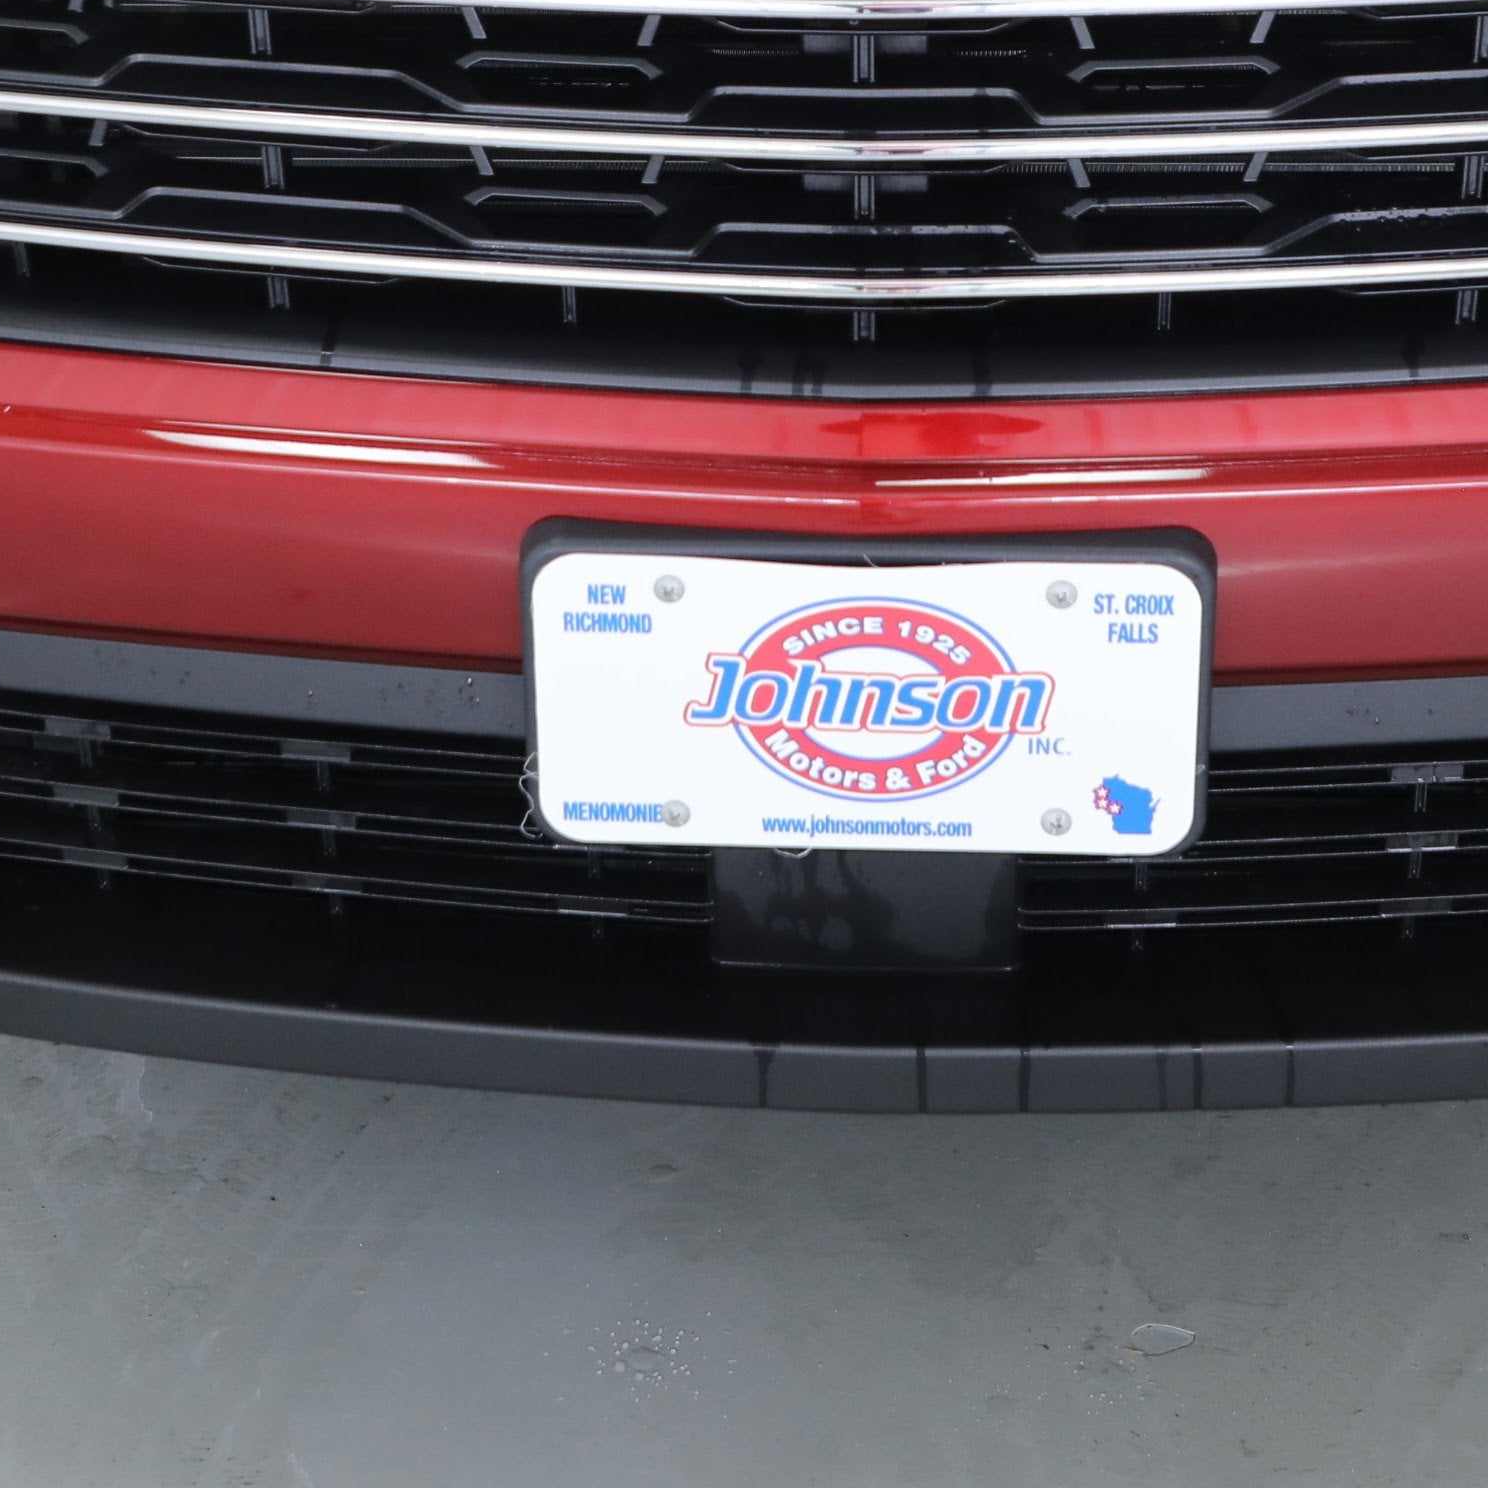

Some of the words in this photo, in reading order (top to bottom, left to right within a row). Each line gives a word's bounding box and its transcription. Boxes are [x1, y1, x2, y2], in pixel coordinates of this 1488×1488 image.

[587, 584, 626, 604] NEW
[1093, 593, 1119, 614] ST.
[1125, 593, 1174, 615] CROIX
[563, 611, 652, 633] RICHMOND
[1107, 622, 1159, 644] FALLS
[782, 615, 885, 657] SINCE
[897, 619, 973, 666] 1925
[687, 657, 1049, 730] Johnson
[1027, 737, 1072, 756] INC.
[763, 728, 878, 791] Motors
[884, 767, 912, 792] &
[914, 733, 988, 785] Ford
[761, 814, 973, 838] www.johnsonmotors.com
